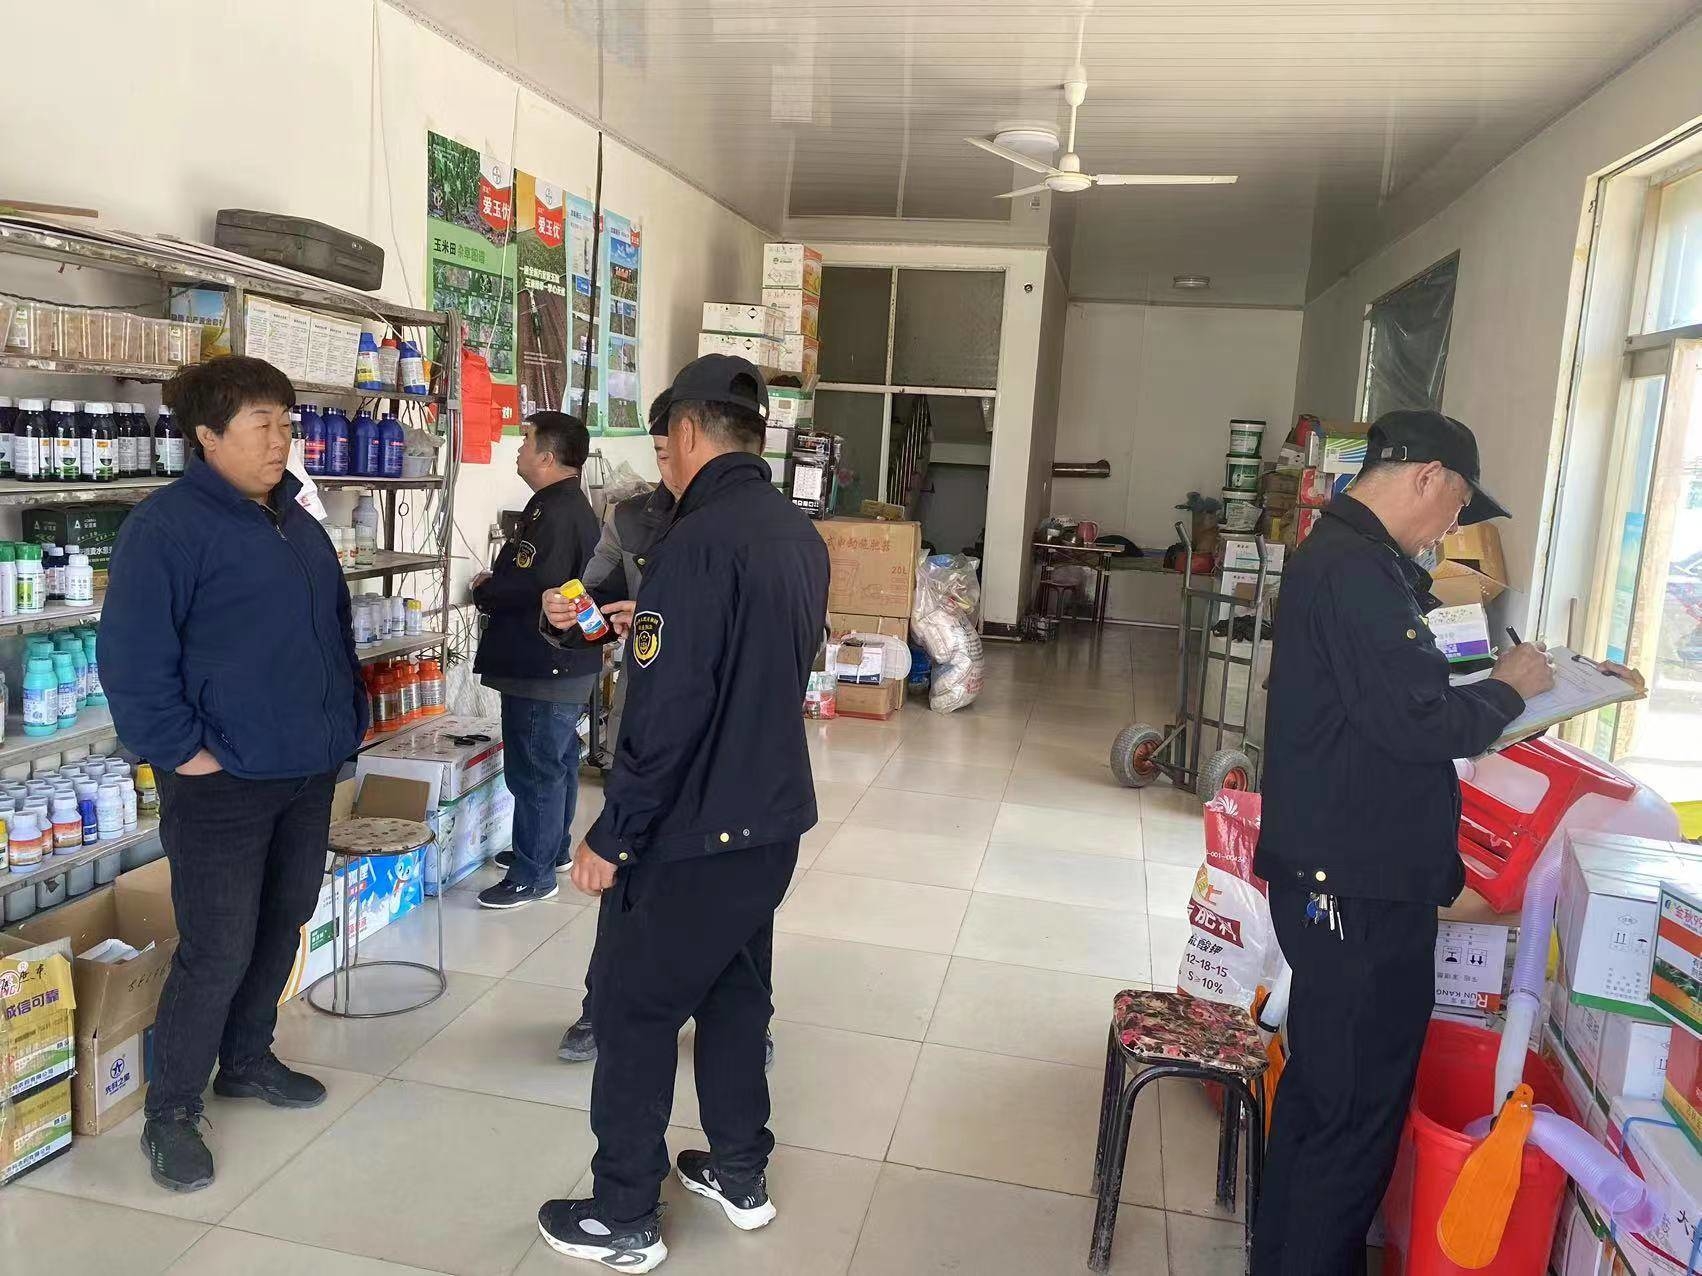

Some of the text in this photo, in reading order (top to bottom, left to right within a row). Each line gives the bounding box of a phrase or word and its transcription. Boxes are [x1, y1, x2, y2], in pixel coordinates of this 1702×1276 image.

[891, 566, 908, 575] 20L
[1186, 953, 1229, 978] 12-18-15
[1436, 988, 1461, 998] KANG
